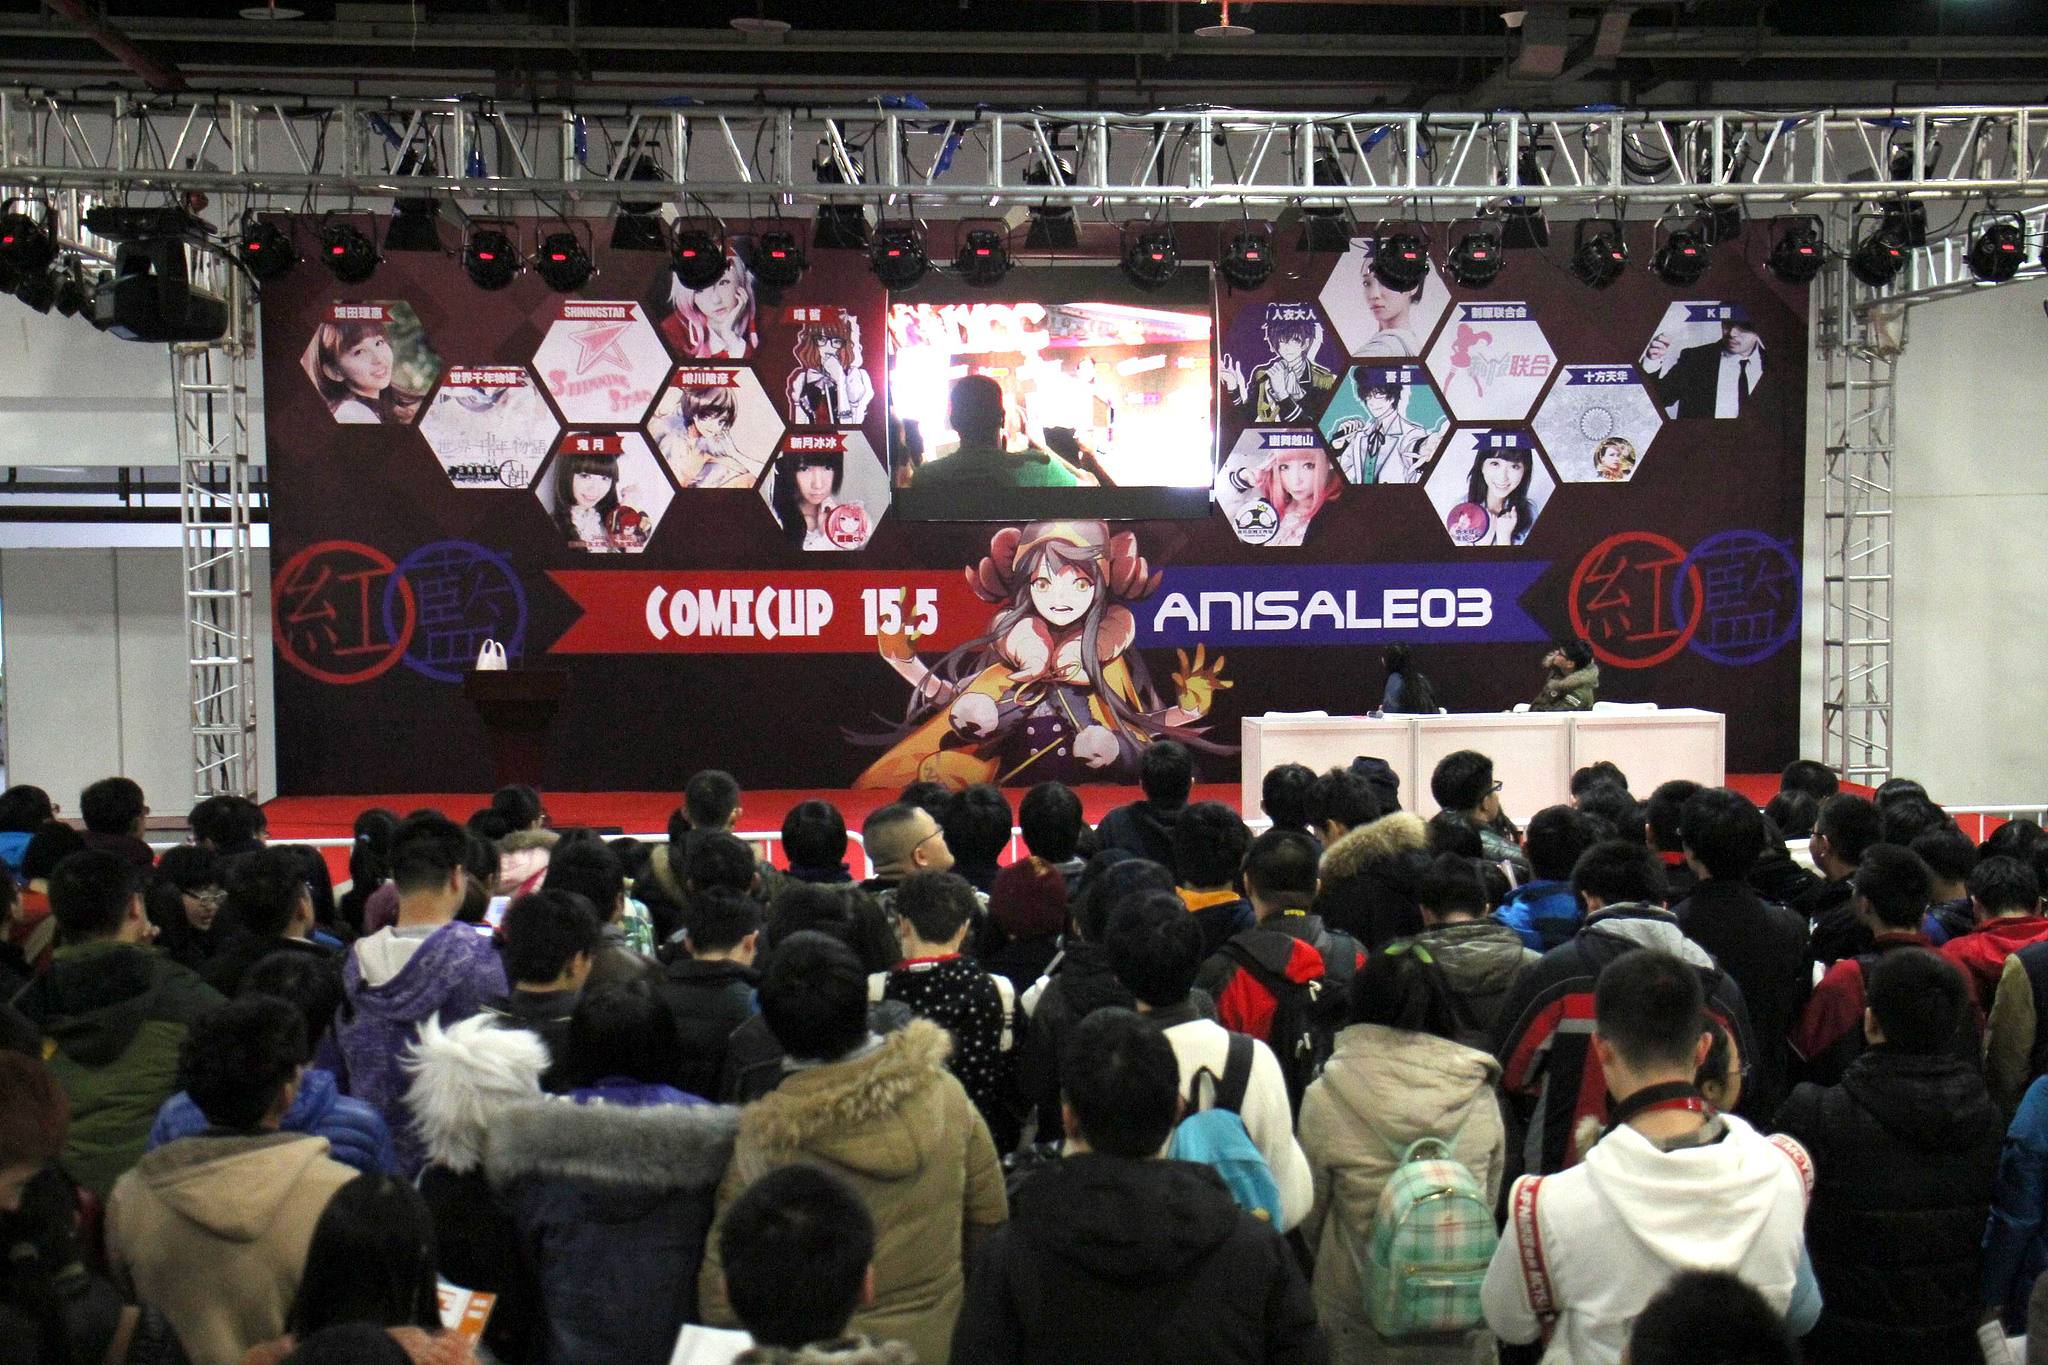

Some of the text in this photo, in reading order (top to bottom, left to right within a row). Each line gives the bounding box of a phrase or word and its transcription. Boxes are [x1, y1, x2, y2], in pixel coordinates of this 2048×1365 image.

[564, 306, 625, 318] SHININGSTAR
[1272, 309, 1317, 321] 人衣大人
[1584, 371, 1629, 383] 十方天华
[577, 438, 605, 451] 鬼月
[790, 436, 837, 449] 新月冰冰
[645, 585, 938, 640] COMICUP 15.5
